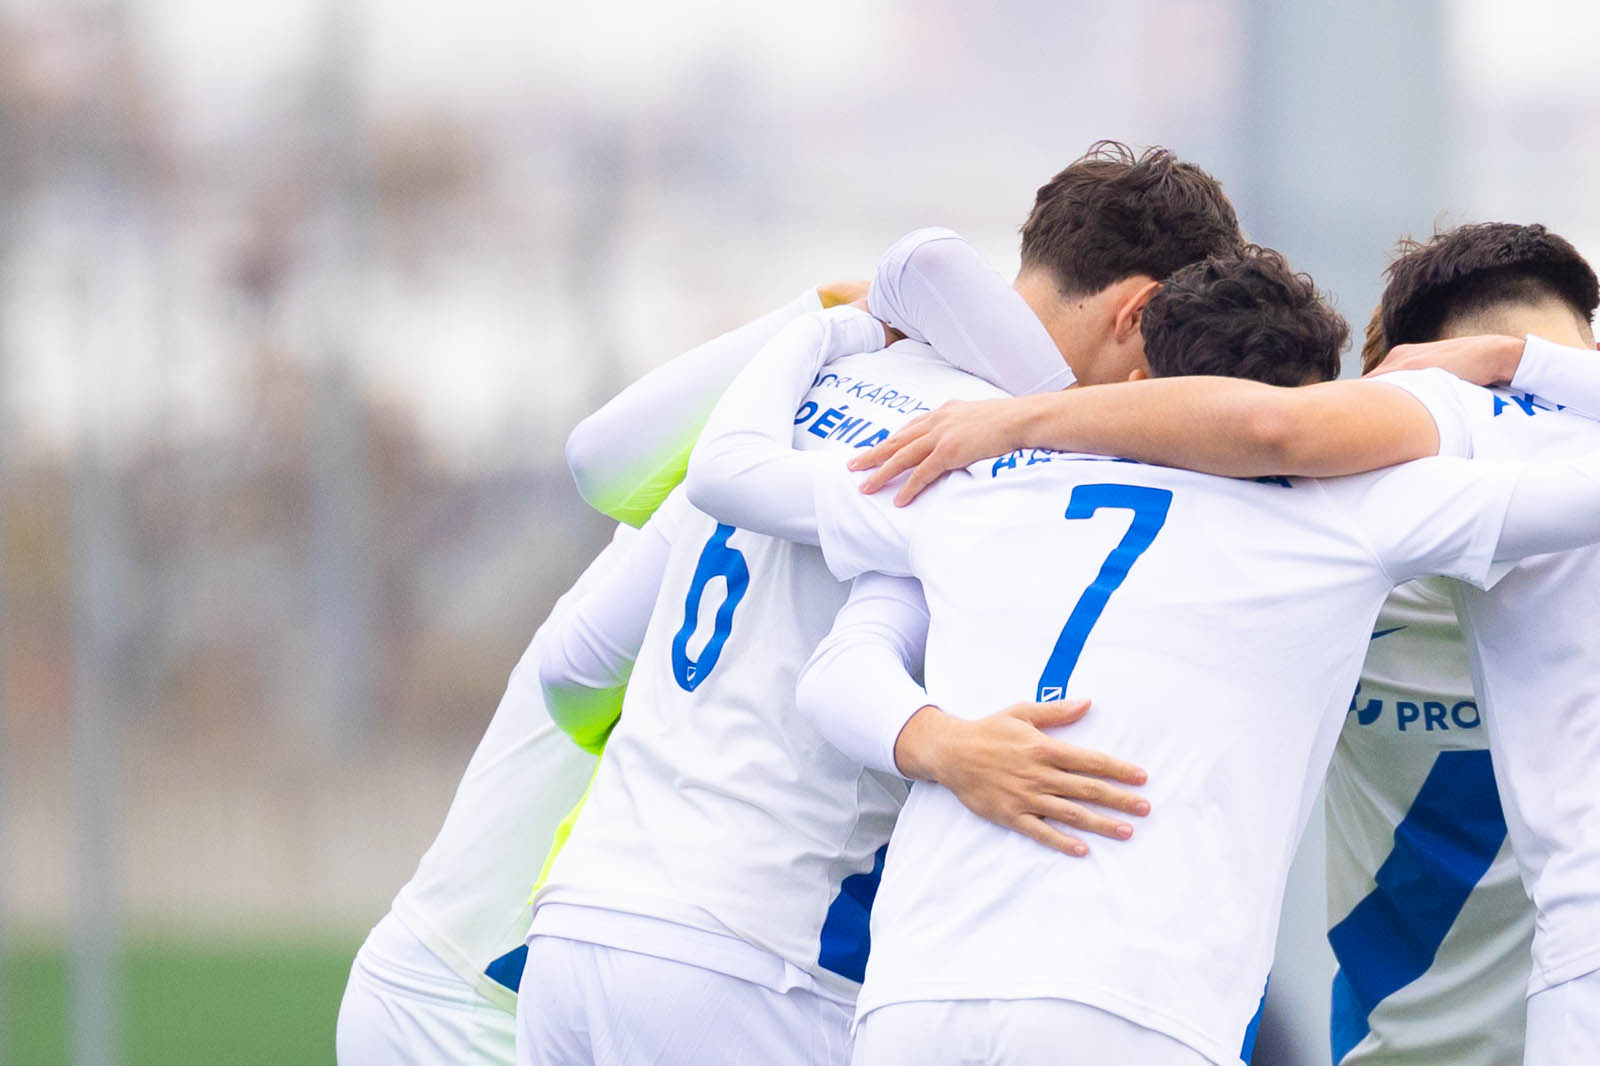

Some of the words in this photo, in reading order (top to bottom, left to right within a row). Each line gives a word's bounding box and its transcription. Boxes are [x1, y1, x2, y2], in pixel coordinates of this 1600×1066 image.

[671, 522, 750, 692] 6
[1035, 483, 1173, 703] 7
[1396, 700, 1481, 731] PRO
